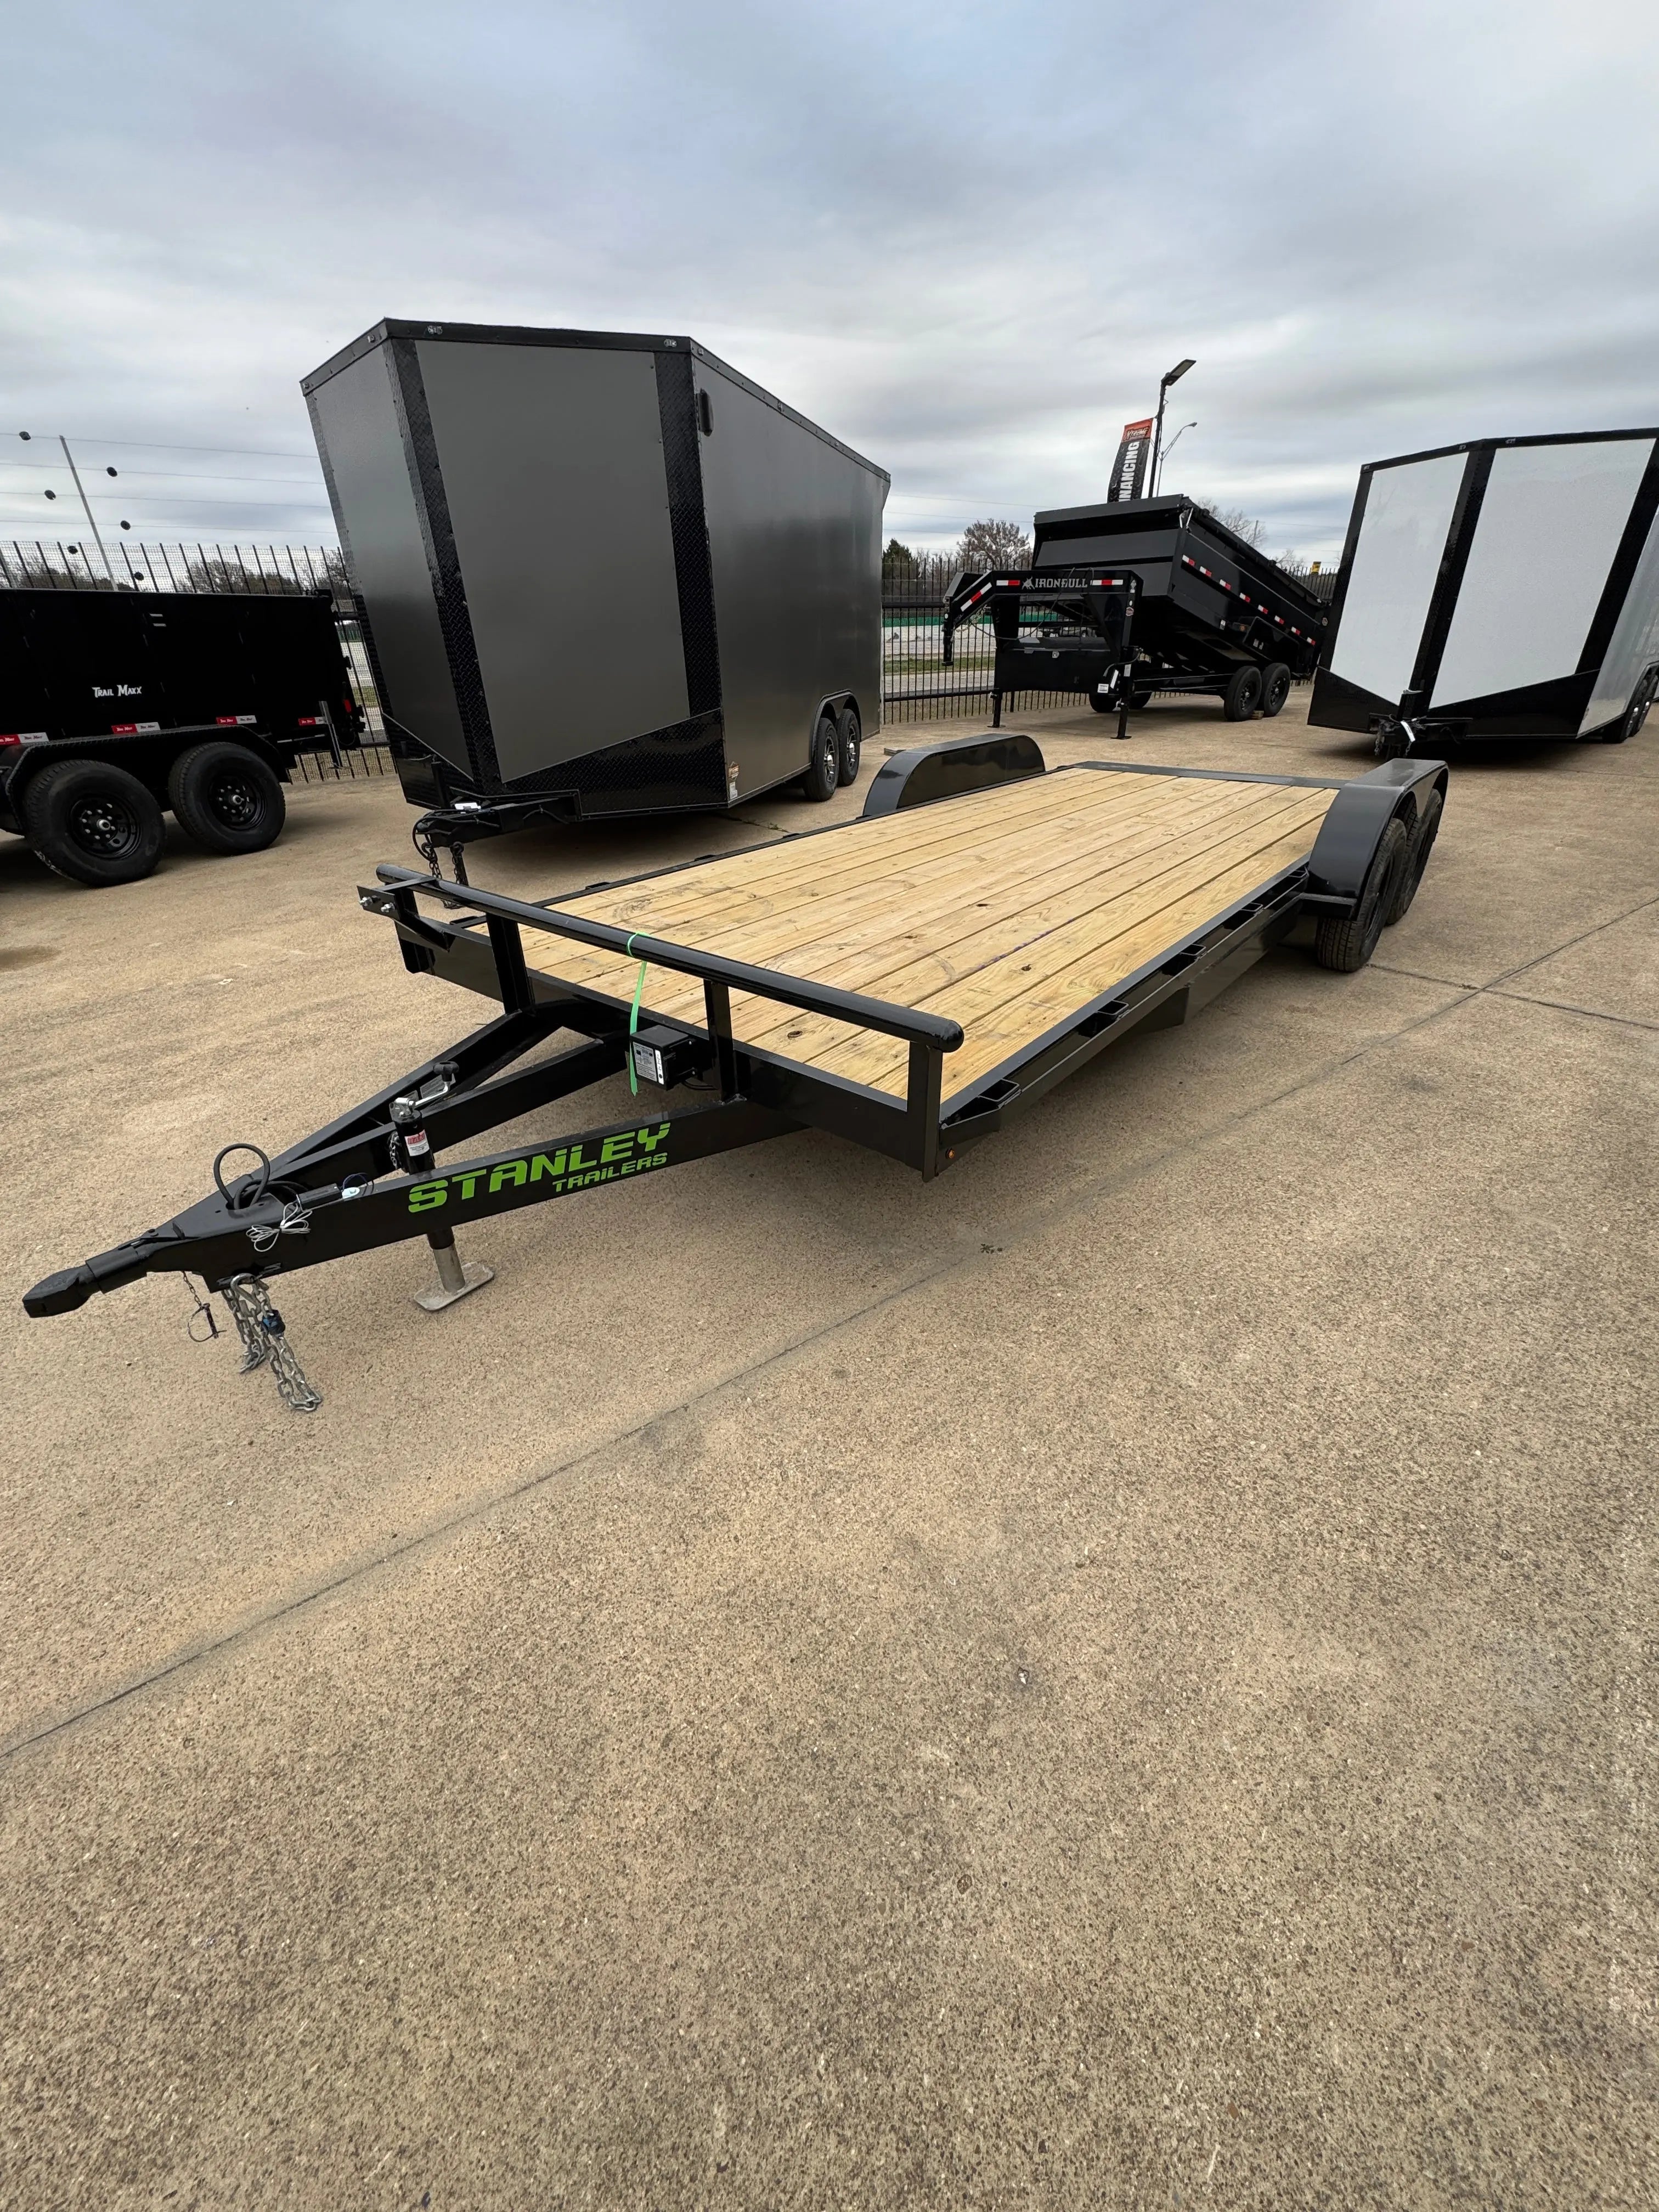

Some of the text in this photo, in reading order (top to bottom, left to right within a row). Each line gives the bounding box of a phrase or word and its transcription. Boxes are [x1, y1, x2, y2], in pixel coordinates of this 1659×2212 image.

[1118, 441, 1140, 502] INANCING
[408, 1122, 671, 1213] STANLEY
[552, 1152, 668, 1192] TRAILERS
